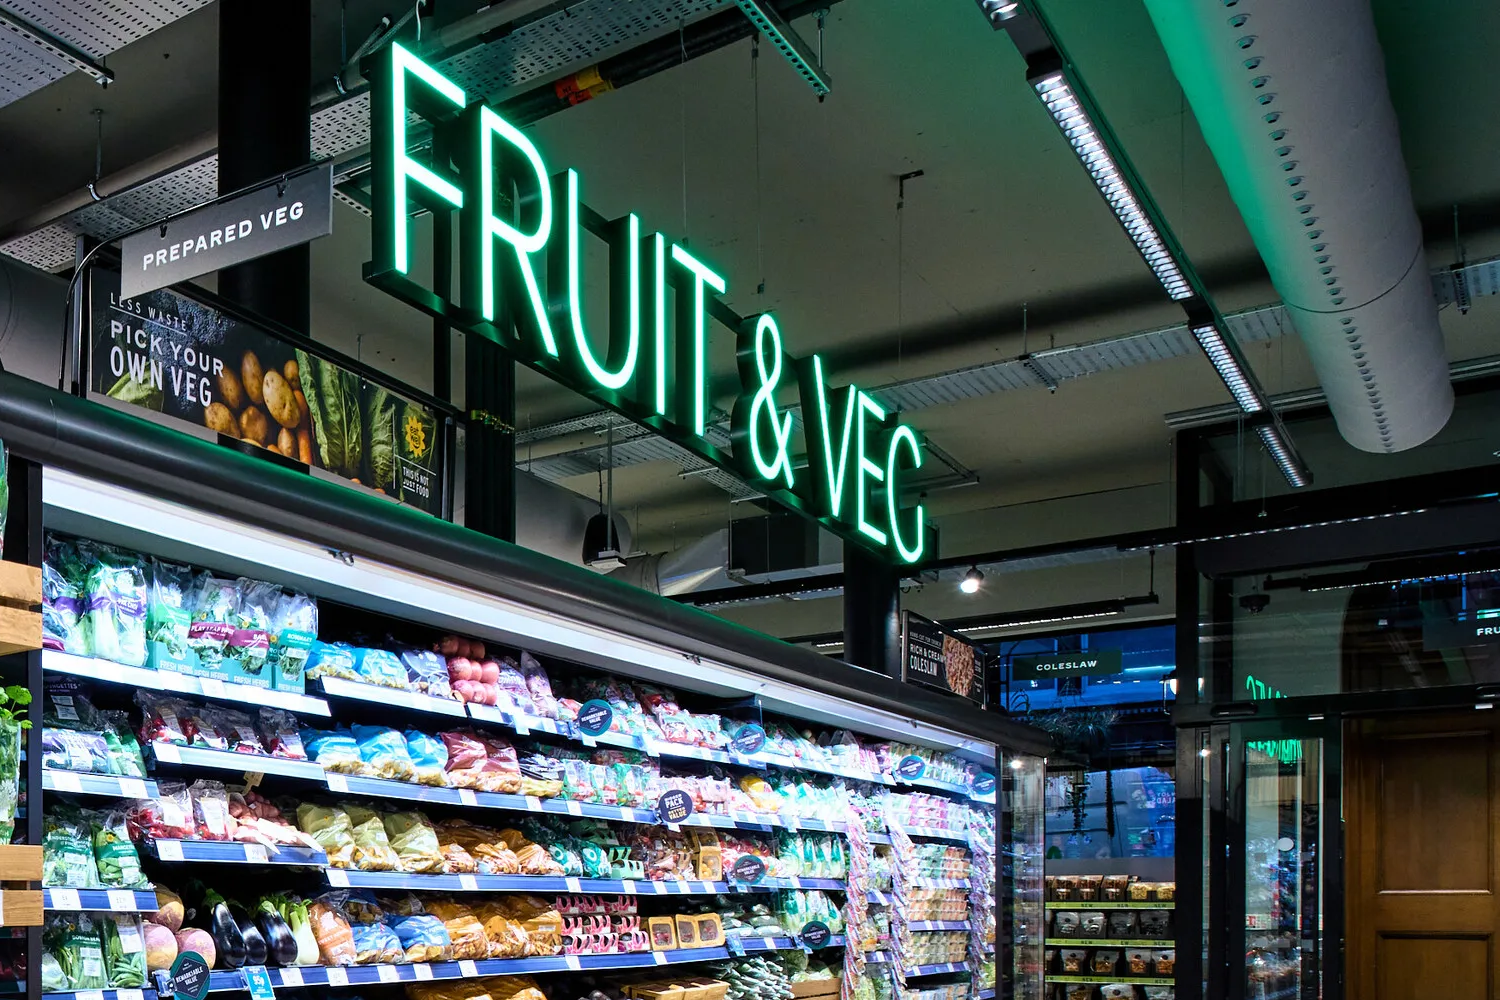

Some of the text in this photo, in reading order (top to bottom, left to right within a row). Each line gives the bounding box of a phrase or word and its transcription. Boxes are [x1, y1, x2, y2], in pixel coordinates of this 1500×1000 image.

[143, 202, 304, 271] PREPARED VEG
[111, 292, 188, 332] LESS WASTE
[391, 41, 924, 563] FRUIT & VEG
[111, 320, 224, 378] PICK YOUR
[110, 346, 212, 407] OWN VEG
[403, 466, 414, 480] THIS
[420, 475, 429, 486] NOT
[403, 481, 429, 498] JUST FOOD
[910, 643, 922, 654] RICH
[910, 655, 937, 676] COLESLAW
[1036, 660, 1097, 671] COLESLAW
[665, 798, 684, 808] PACK
[176, 966, 203, 983] REMARKABLE
[184, 975, 198, 986] VALUE
